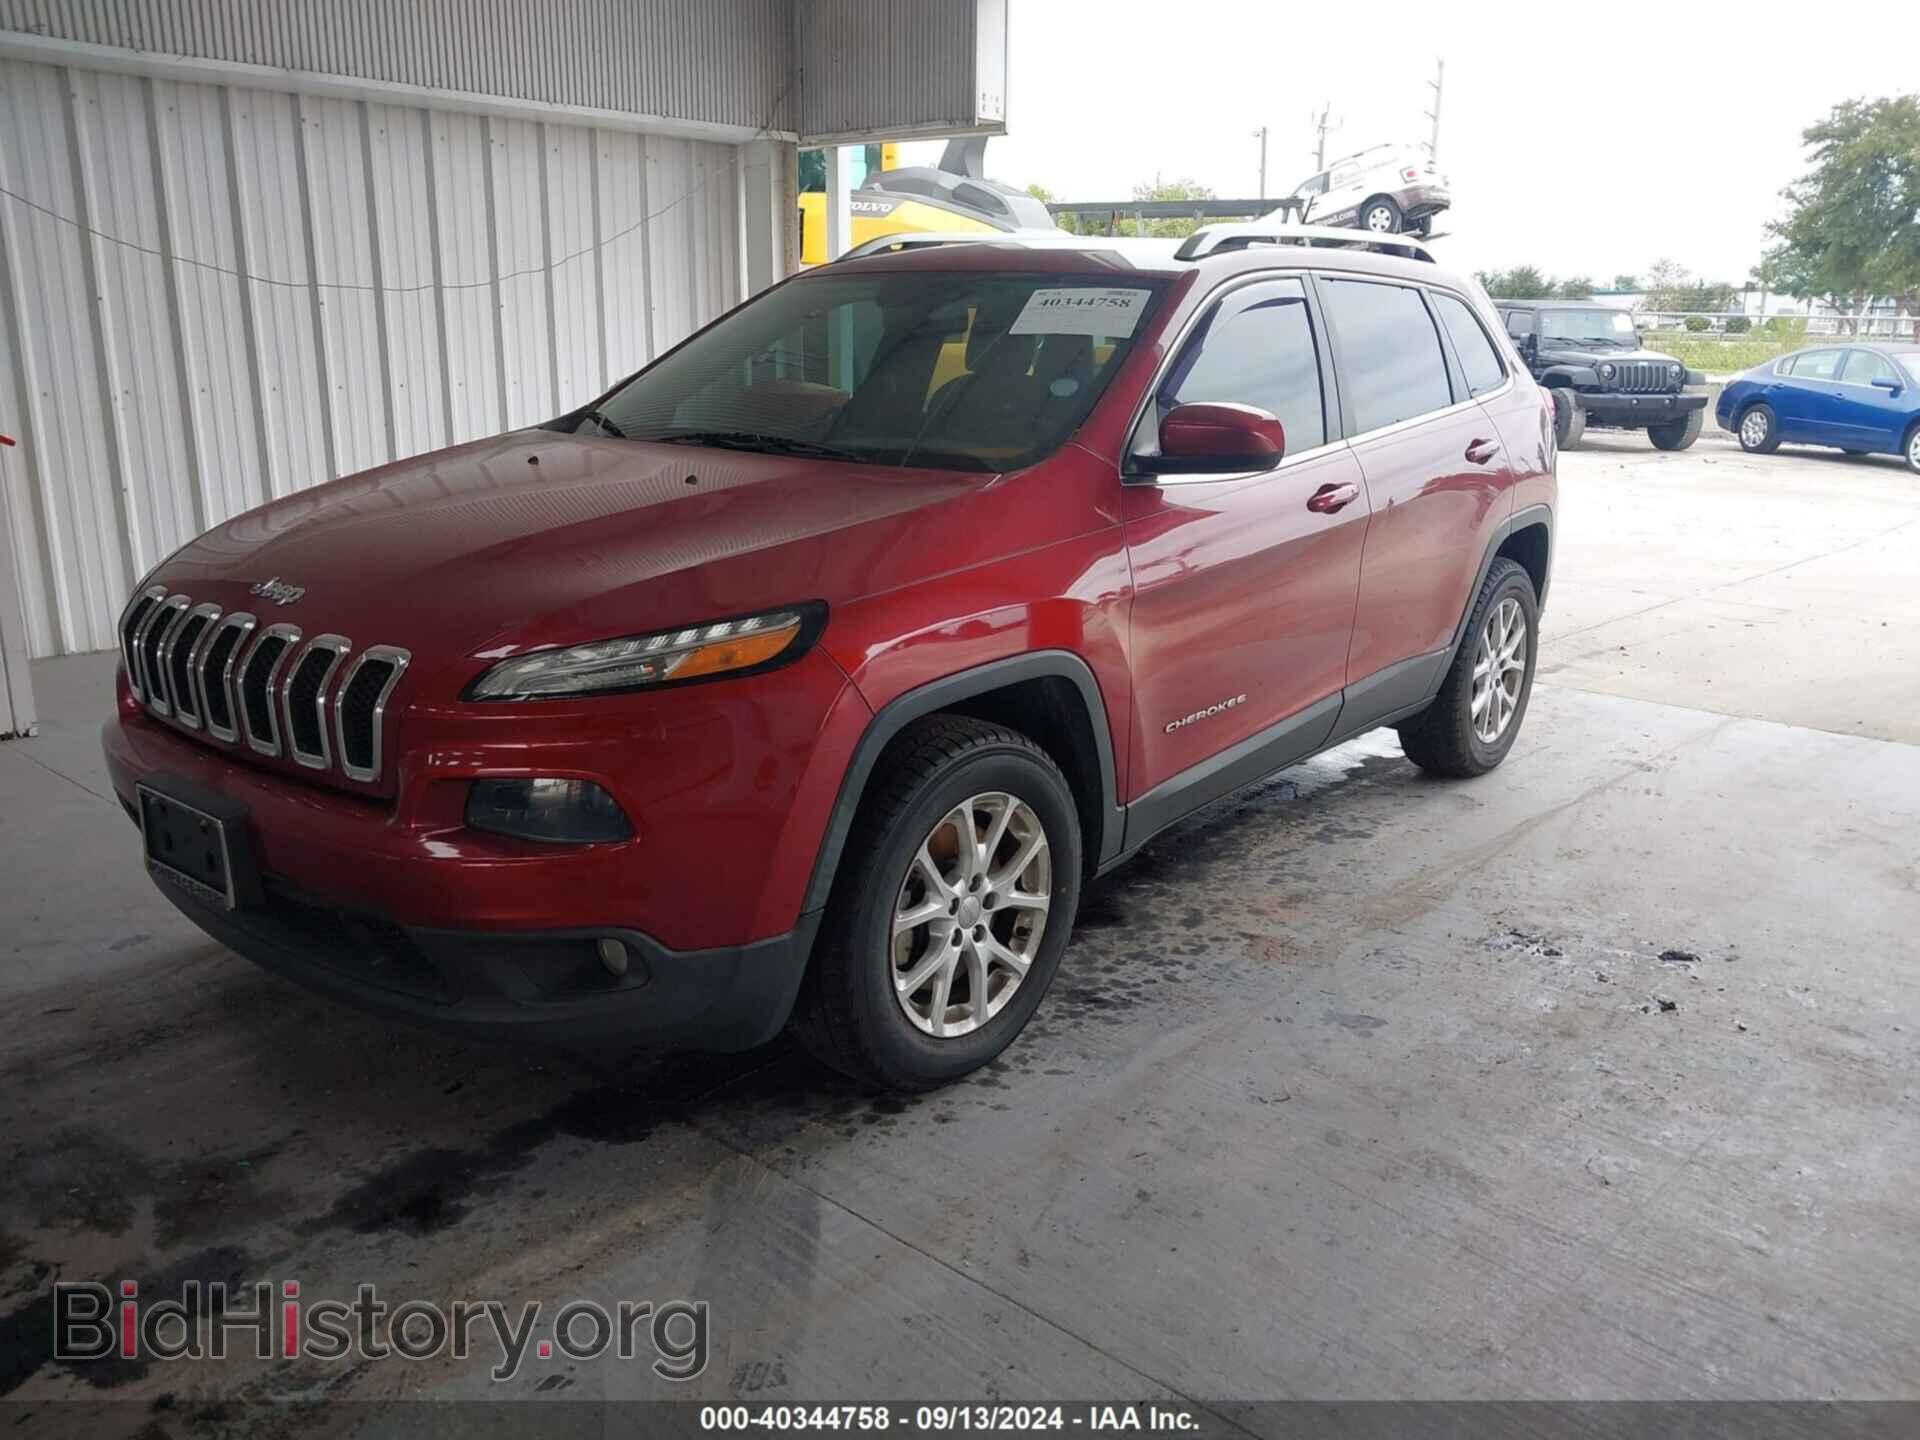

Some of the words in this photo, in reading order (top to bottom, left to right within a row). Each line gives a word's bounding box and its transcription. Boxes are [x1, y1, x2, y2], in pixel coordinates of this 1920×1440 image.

[850, 201, 893, 212] OLVO
[1039, 297, 1131, 308] 40344758
[247, 576, 305, 606] Jeep
[1165, 693, 1247, 733] CHEROKEE
